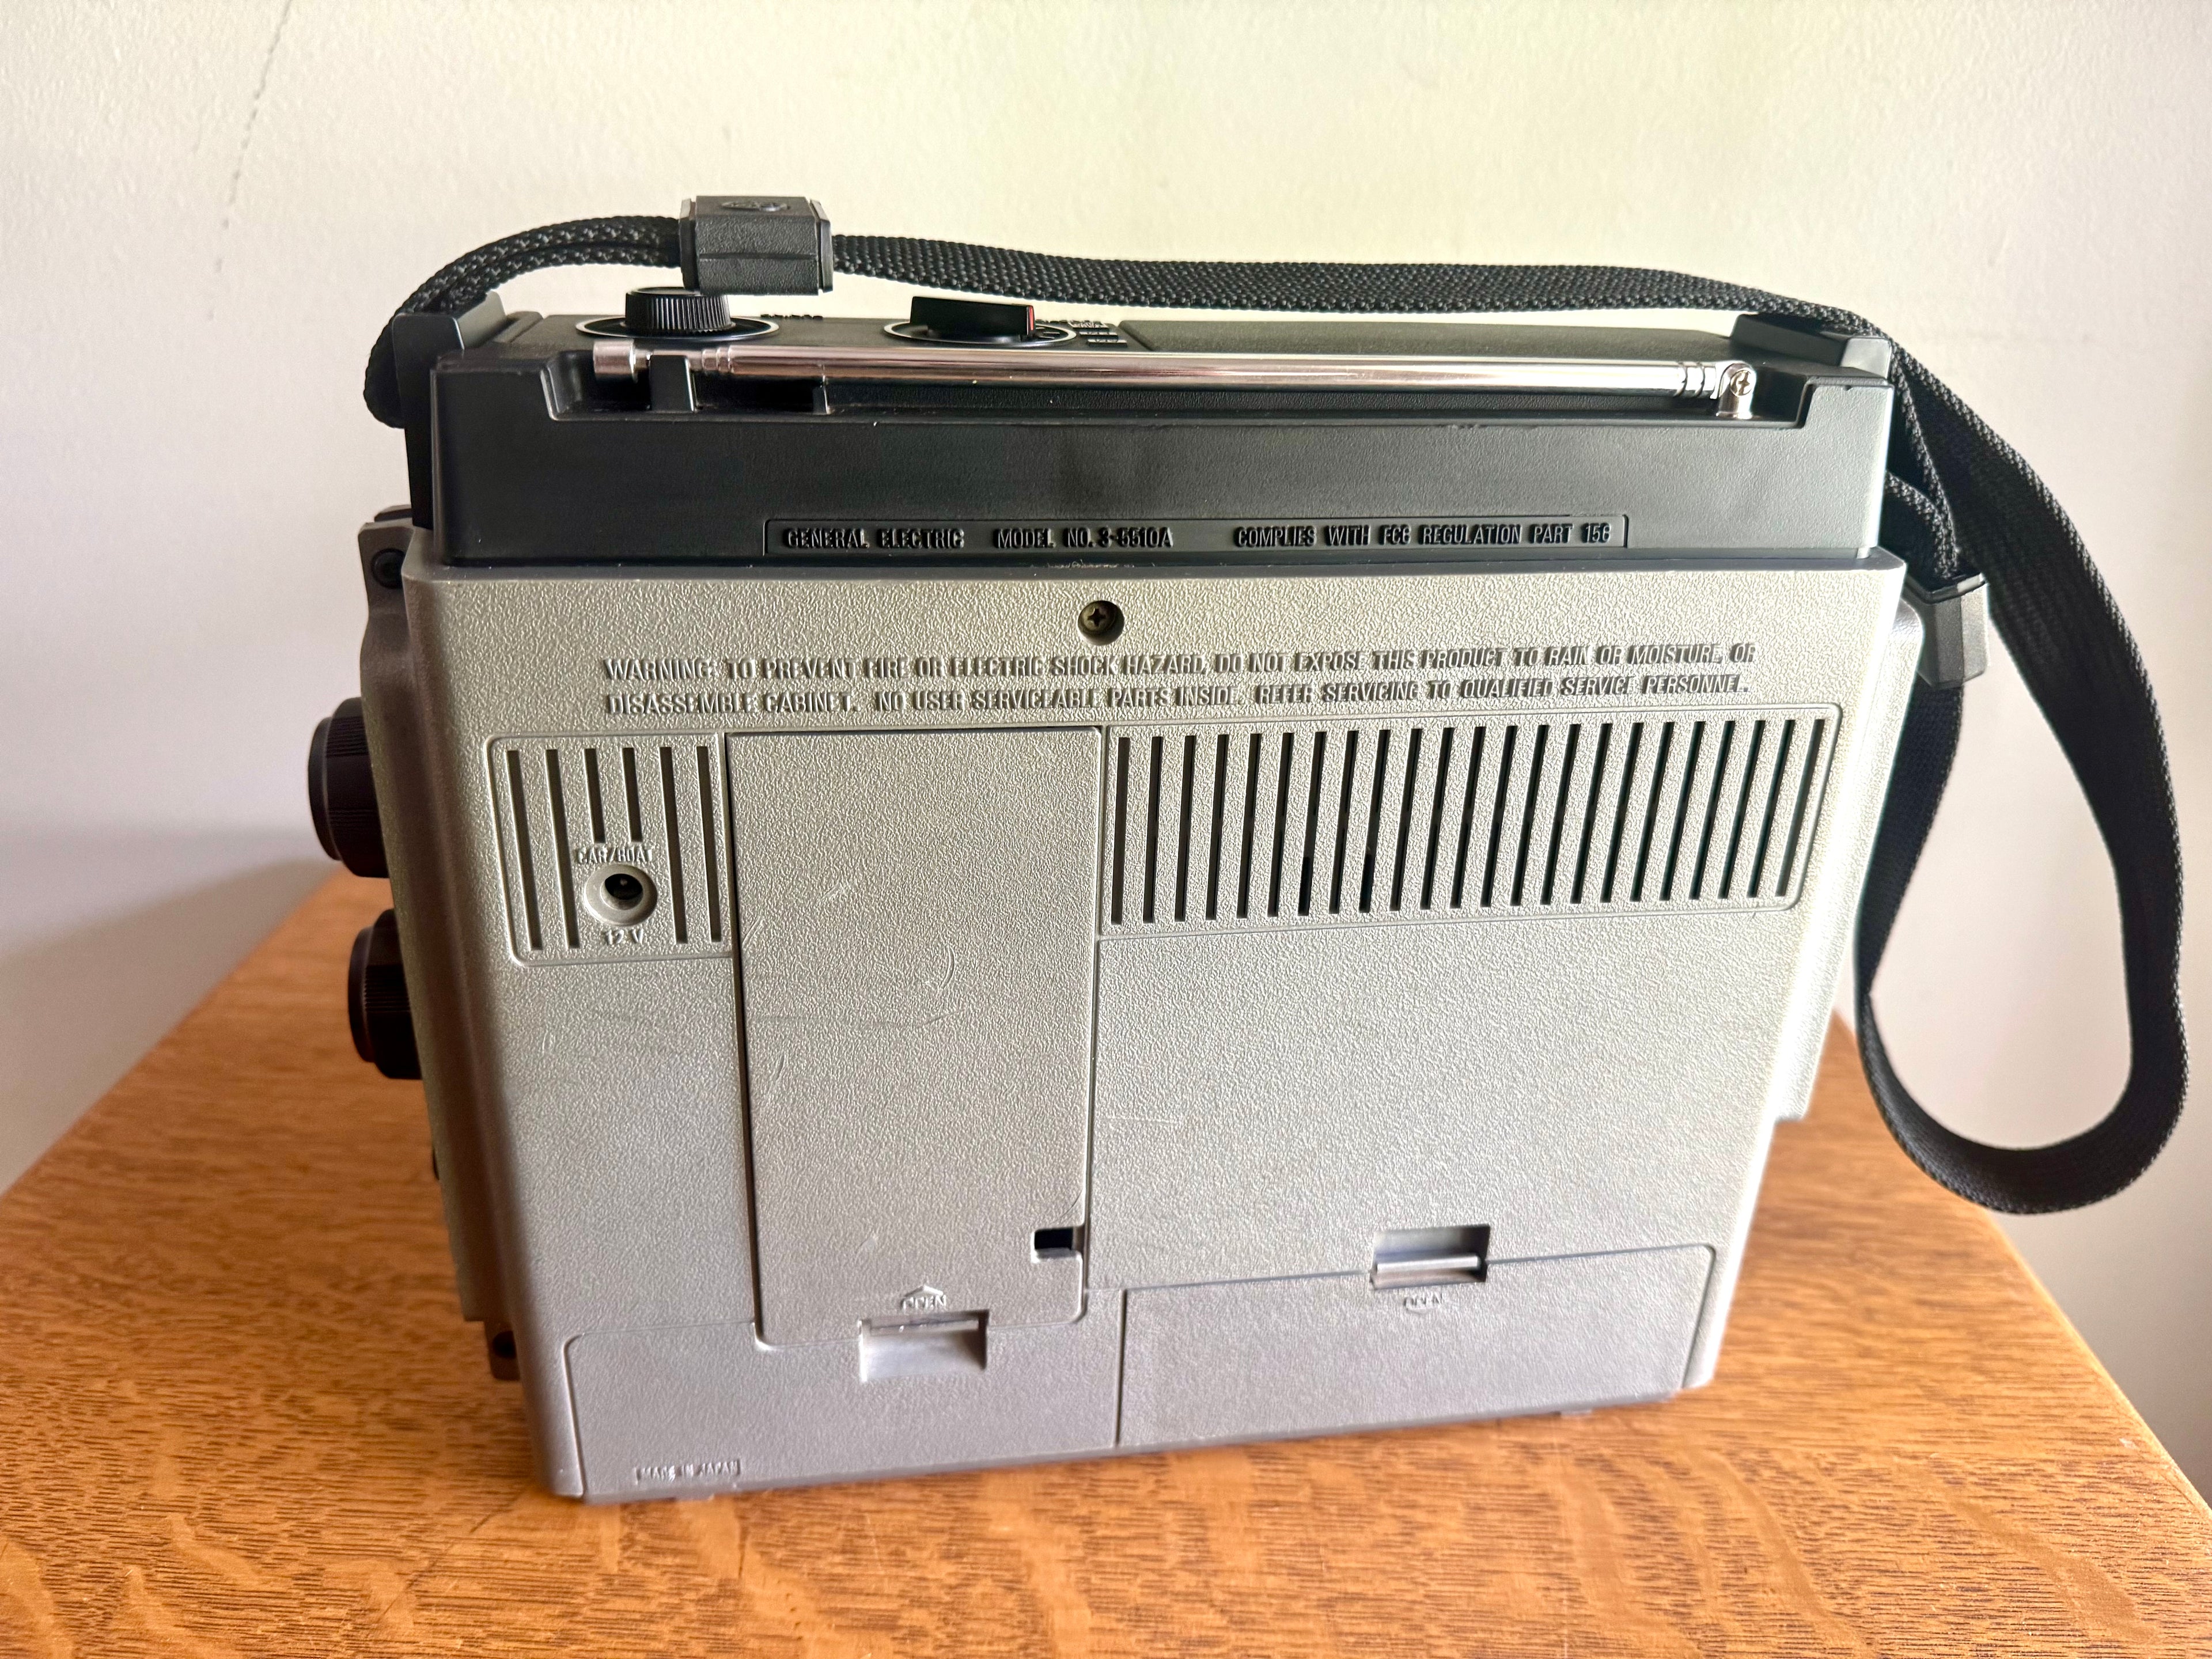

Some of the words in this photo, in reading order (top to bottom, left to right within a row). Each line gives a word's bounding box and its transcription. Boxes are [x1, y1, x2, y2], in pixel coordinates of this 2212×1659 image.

[785, 527, 869, 549] GENERAL
[878, 527, 964, 549] ELECTRIC
[995, 527, 1055, 549] MODEL
[1065, 527, 1095, 548] NO.
[1235, 525, 1316, 547] COMPLIES
[1327, 525, 1370, 546] WITH
[1419, 523, 1522, 546] REGULATION
[1530, 522, 1574, 545] PART
[605, 657, 719, 681] WARNING:
[729, 657, 756, 681] TO
[763, 657, 859, 681] PREVENT
[867, 657, 912, 680] FIRE
[919, 656, 948, 679] OR
[953, 656, 1044, 678] ELECTRIC
[1053, 654, 1118, 676] SHOCK
[1216, 653, 1243, 674] DO
[1250, 652, 1288, 674] NOT
[1297, 651, 1369, 673] EXPOSE
[1373, 649, 1417, 671] THIS
[1423, 647, 1506, 670] PRODUCT
[1513, 647, 1540, 668] TO
[1546, 646, 1592, 667] RAIN
[1597, 646, 1622, 666] OR
[1730, 643, 1757, 664] OR
[608, 691, 759, 715] DISASSEMBLE
[876, 690, 906, 713] NO
[914, 689, 968, 713] USER
[975, 688, 1103, 712] SERVICEABLE
[1108, 687, 1171, 710] PARTS
[1257, 683, 1318, 706] REFER
[1325, 681, 1420, 705] SERVICING
[1427, 680, 1455, 701] TO
[1461, 678, 1555, 700] QUALIFIED
[1561, 676, 1637, 697] SERVICE
[578, 846, 653, 863] CAR/BOAT
[631, 928, 645, 944] V
